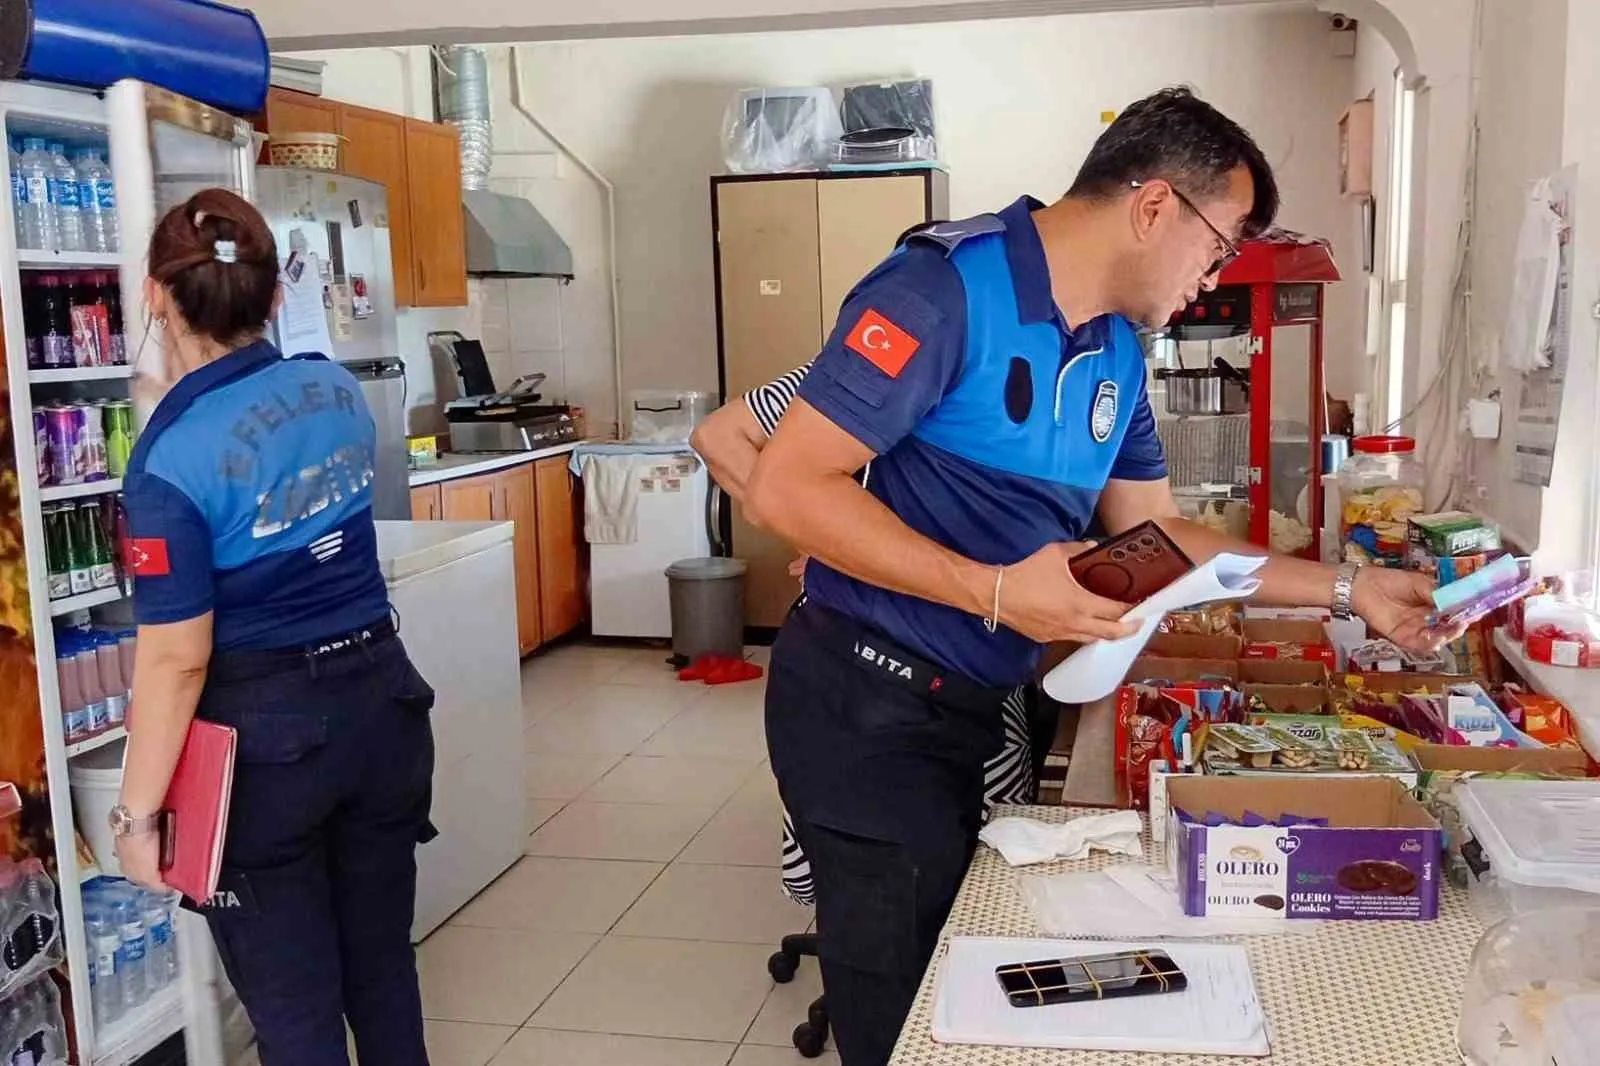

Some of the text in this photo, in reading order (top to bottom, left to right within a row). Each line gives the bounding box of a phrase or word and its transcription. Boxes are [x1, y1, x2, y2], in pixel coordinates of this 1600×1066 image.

[1216, 862, 1279, 876] OLERO
[1208, 896, 1250, 905] OLERO
[1290, 892, 1332, 903] OLERO
[1291, 903, 1331, 913] Cookies
